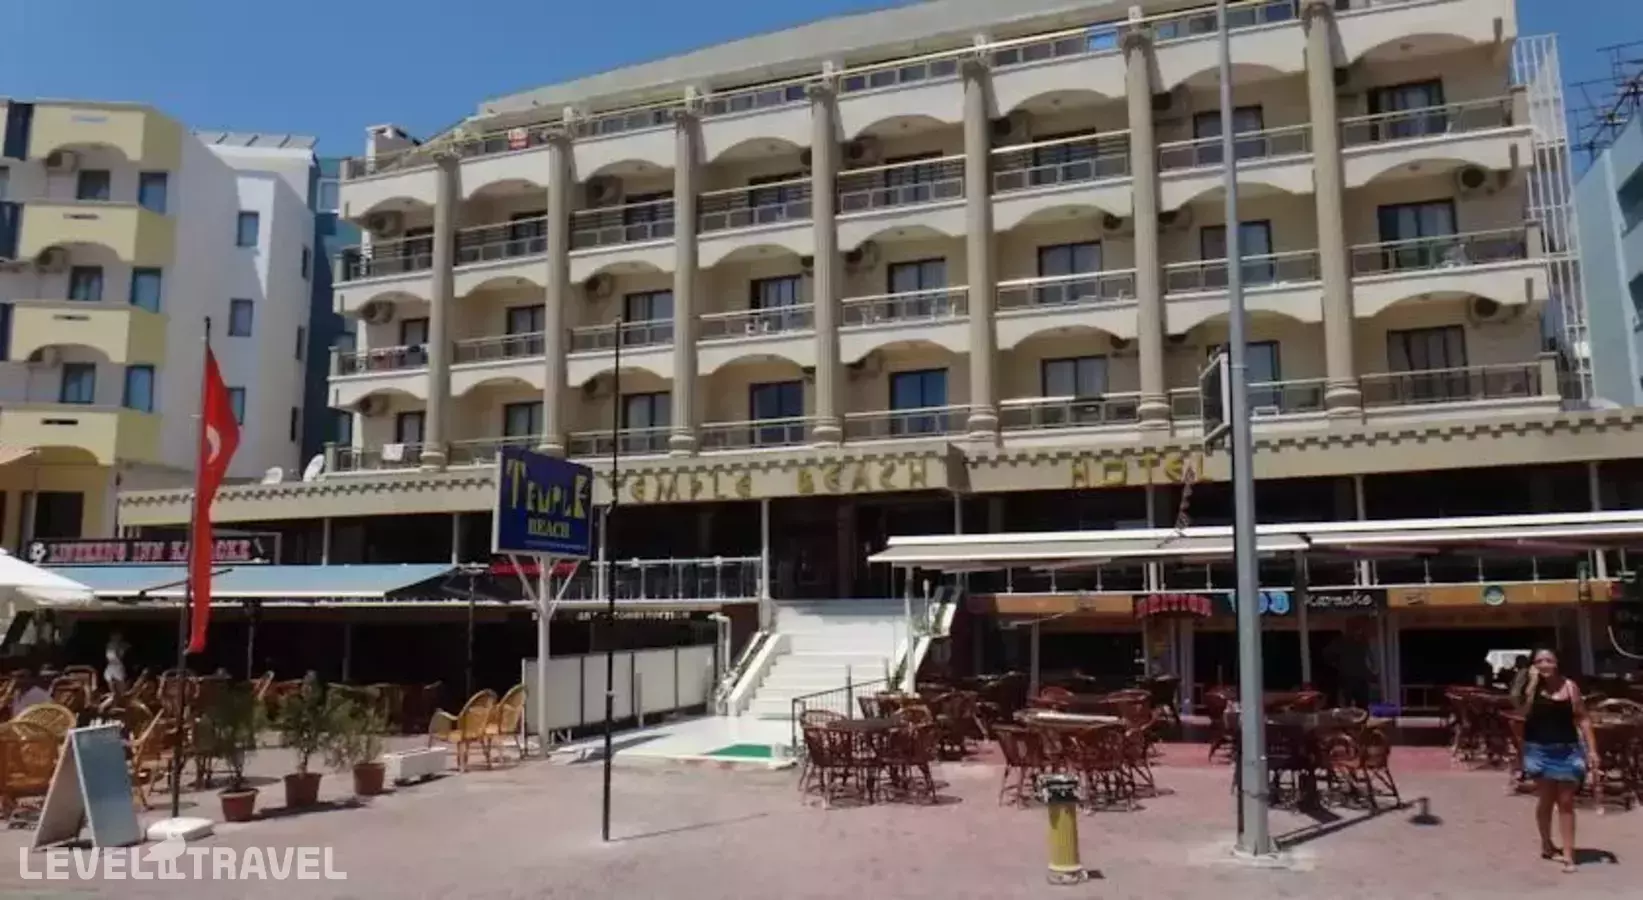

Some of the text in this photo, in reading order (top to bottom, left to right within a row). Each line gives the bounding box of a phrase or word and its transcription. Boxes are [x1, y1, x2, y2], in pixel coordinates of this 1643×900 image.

[506, 459, 588, 519] TEMPLE
[798, 459, 927, 494] BEACH
[1072, 453, 1214, 489] HOTEL
[528, 518, 570, 539] BEACH
